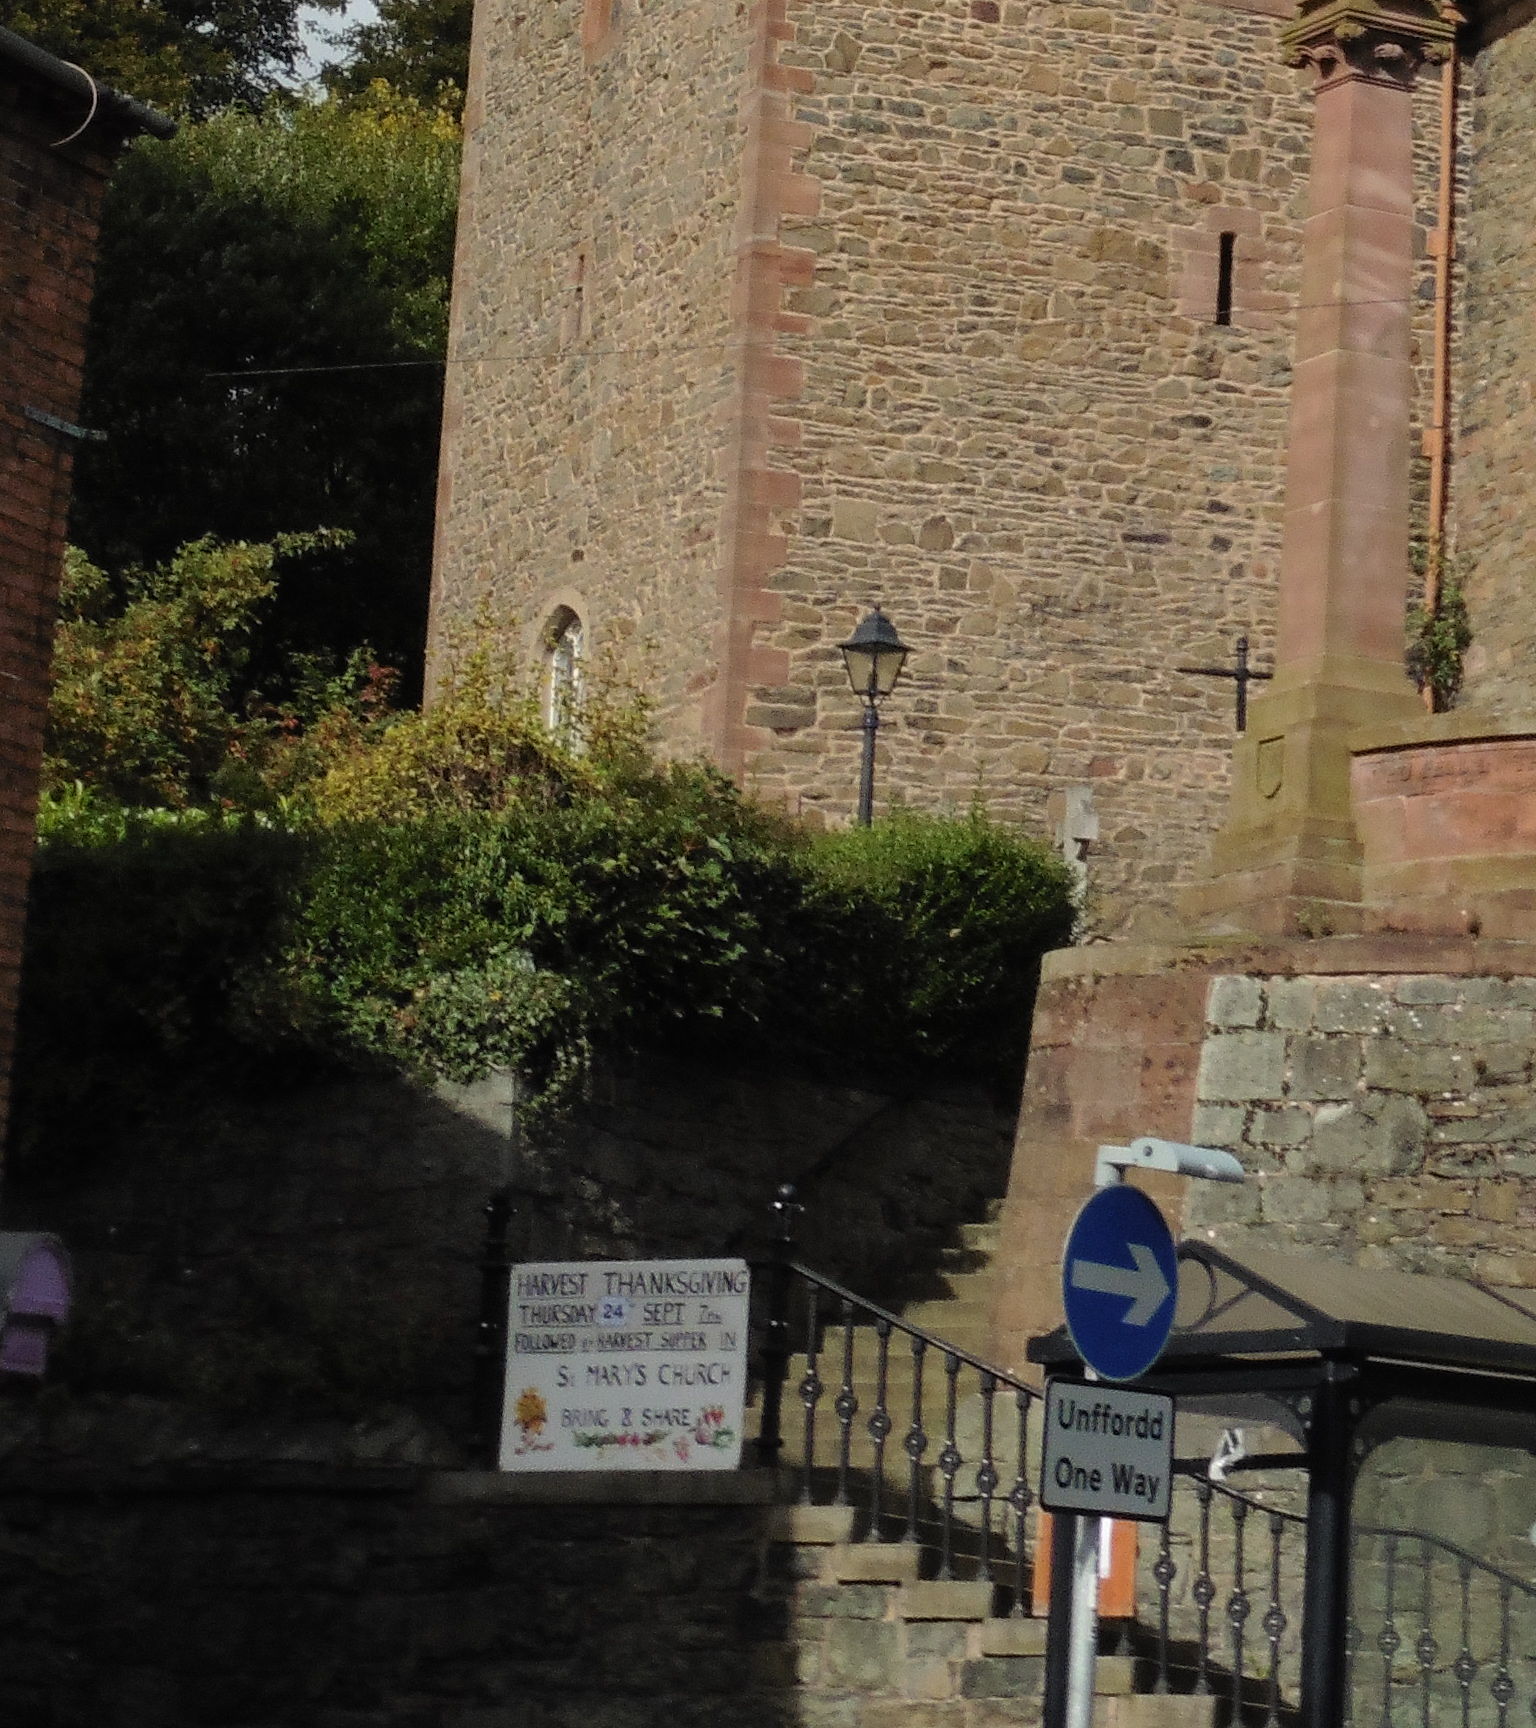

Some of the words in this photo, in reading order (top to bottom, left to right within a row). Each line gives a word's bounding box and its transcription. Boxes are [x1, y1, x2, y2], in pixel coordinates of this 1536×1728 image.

[518, 1273, 588, 1297] HARVEST
[604, 1270, 748, 1295] THANKSGIVING
[519, 1304, 597, 1324] THURSDAY
[603, 1303, 624, 1319] 24
[643, 1302, 686, 1323] SEPT
[658, 1362, 730, 1385] CHURCH
[561, 1407, 609, 1427] BRING
[642, 1408, 690, 1426] SHARE
[1058, 1398, 1163, 1441] Unffordd
[1055, 1457, 1102, 1492] One
[1111, 1462, 1160, 1504] Way
